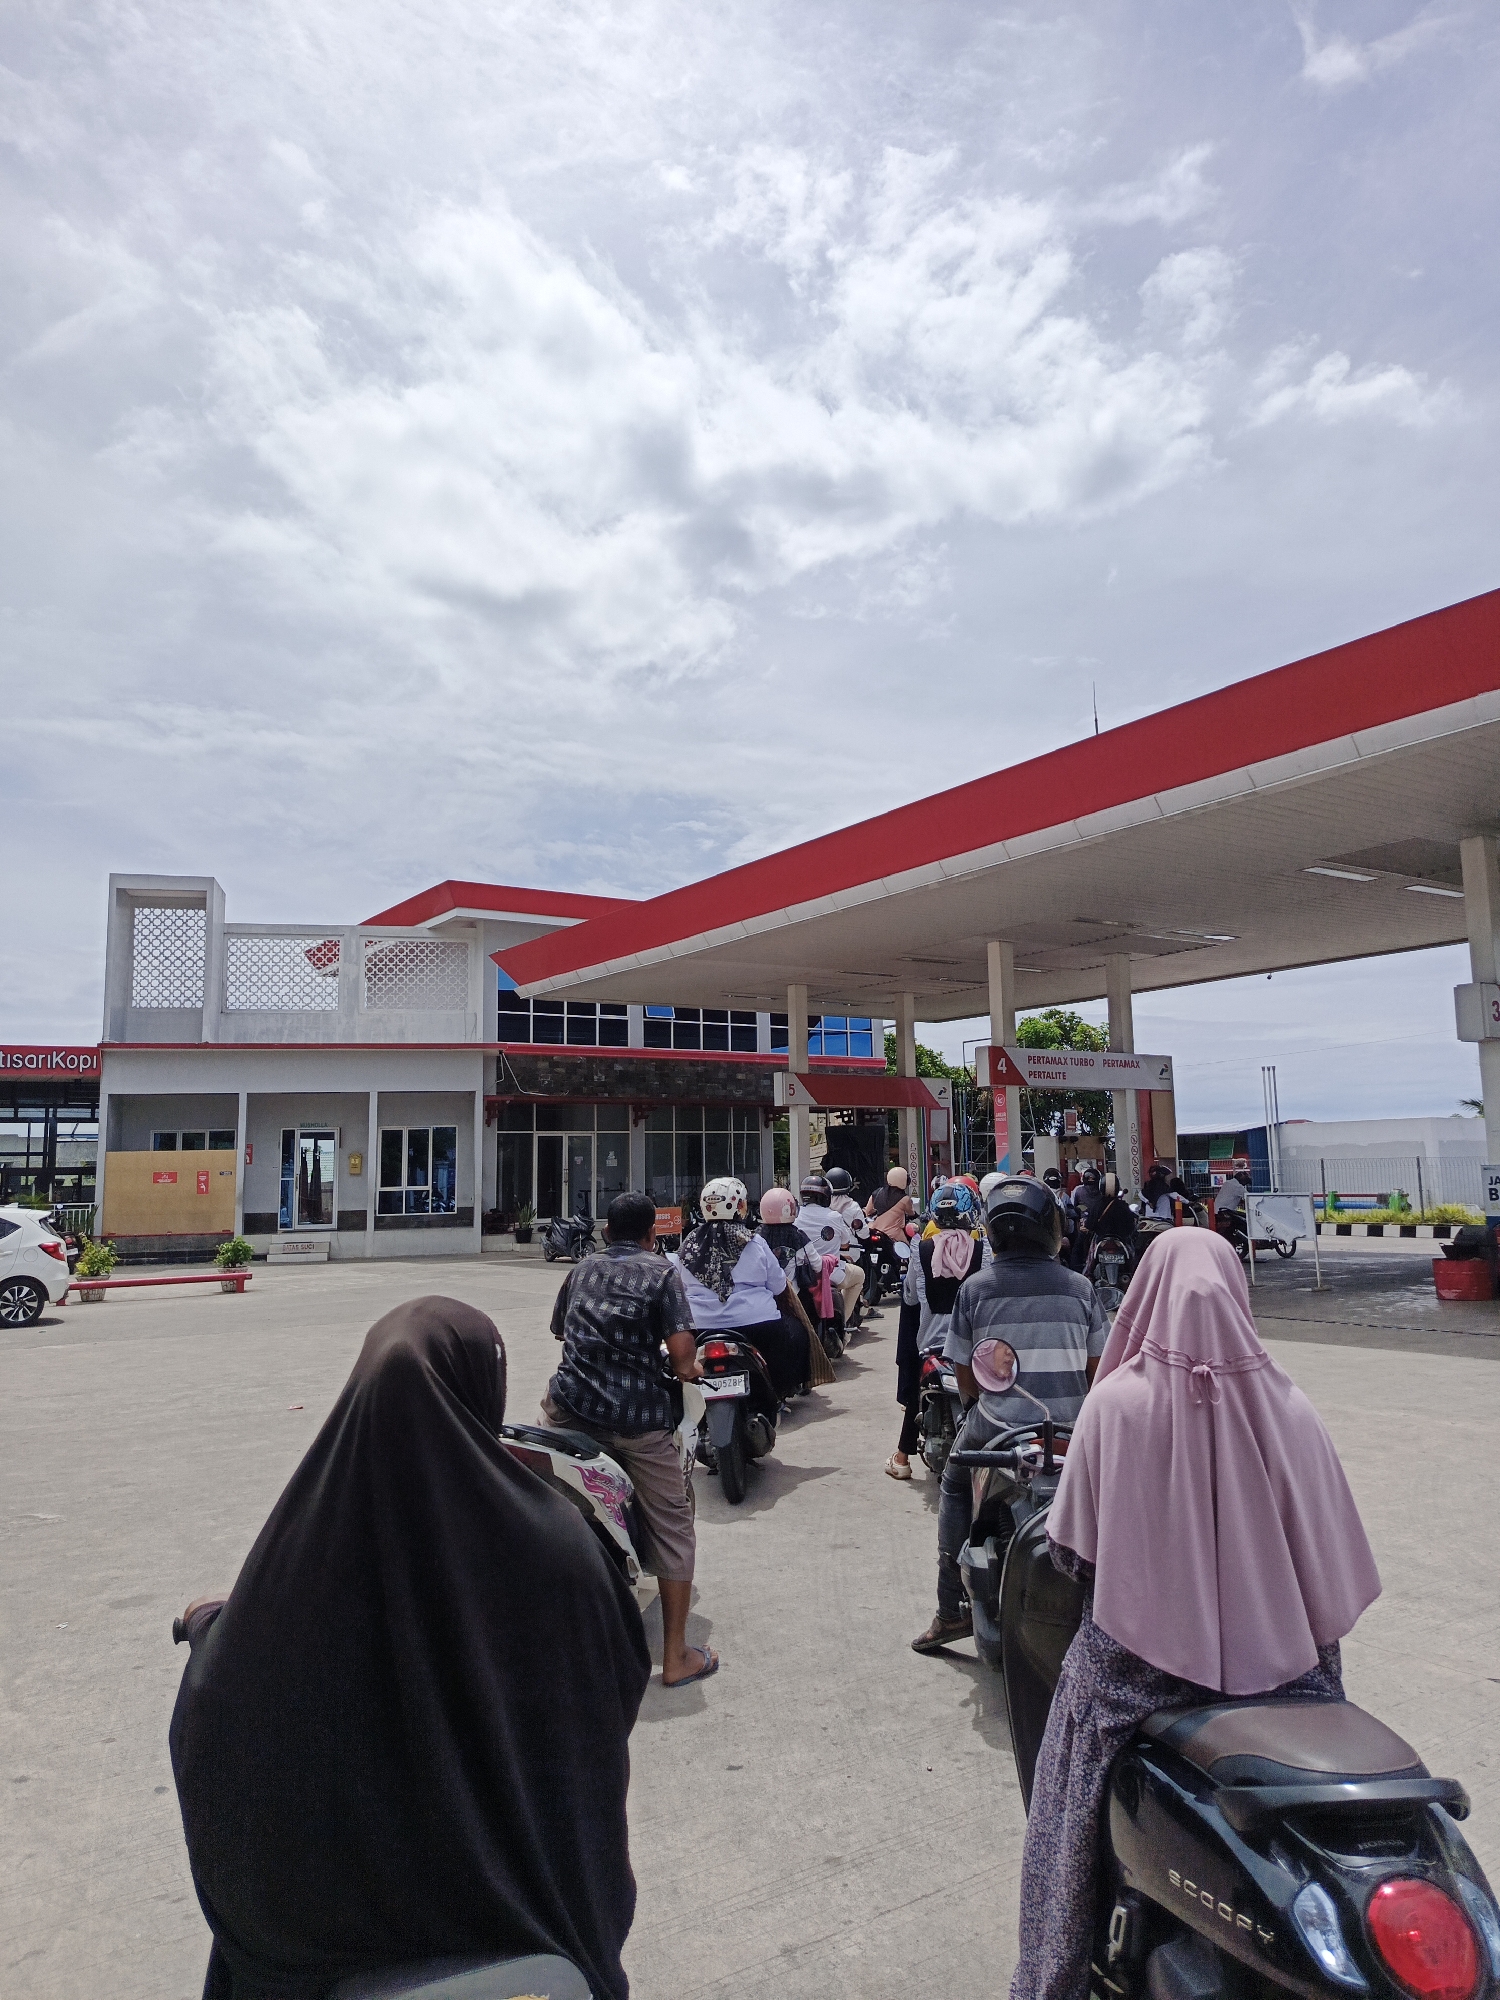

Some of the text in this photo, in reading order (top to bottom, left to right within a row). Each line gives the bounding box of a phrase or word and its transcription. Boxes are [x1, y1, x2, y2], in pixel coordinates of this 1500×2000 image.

[1491, 1000, 1500, 1022] 3
[997, 1057, 1008, 1074] 4
[1027, 1055, 1140, 1069] PERTAMAX TURBO PERTAMAX
[1028, 1070, 1067, 1080] PERTALITE
[788, 1083, 796, 1097] 5
[1168, 1868, 1275, 1945] SCOOPY
